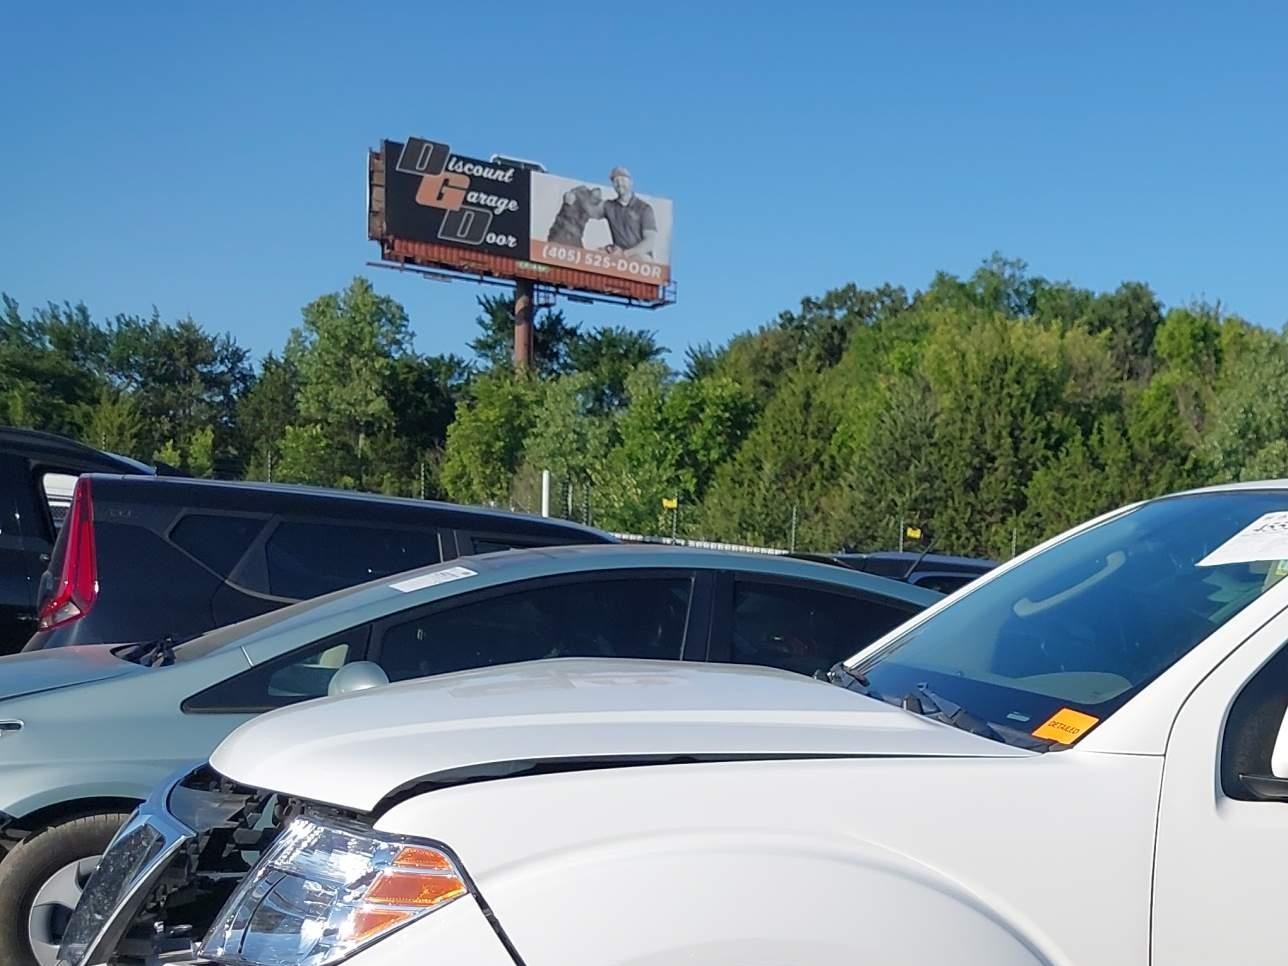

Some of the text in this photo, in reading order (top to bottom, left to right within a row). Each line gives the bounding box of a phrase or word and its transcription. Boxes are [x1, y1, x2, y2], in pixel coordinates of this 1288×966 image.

[396, 136, 515, 183] Discount
[416, 171, 519, 215] Garage
[437, 204, 518, 248] Door
[542, 245, 663, 279] (405) 525-DOOR
